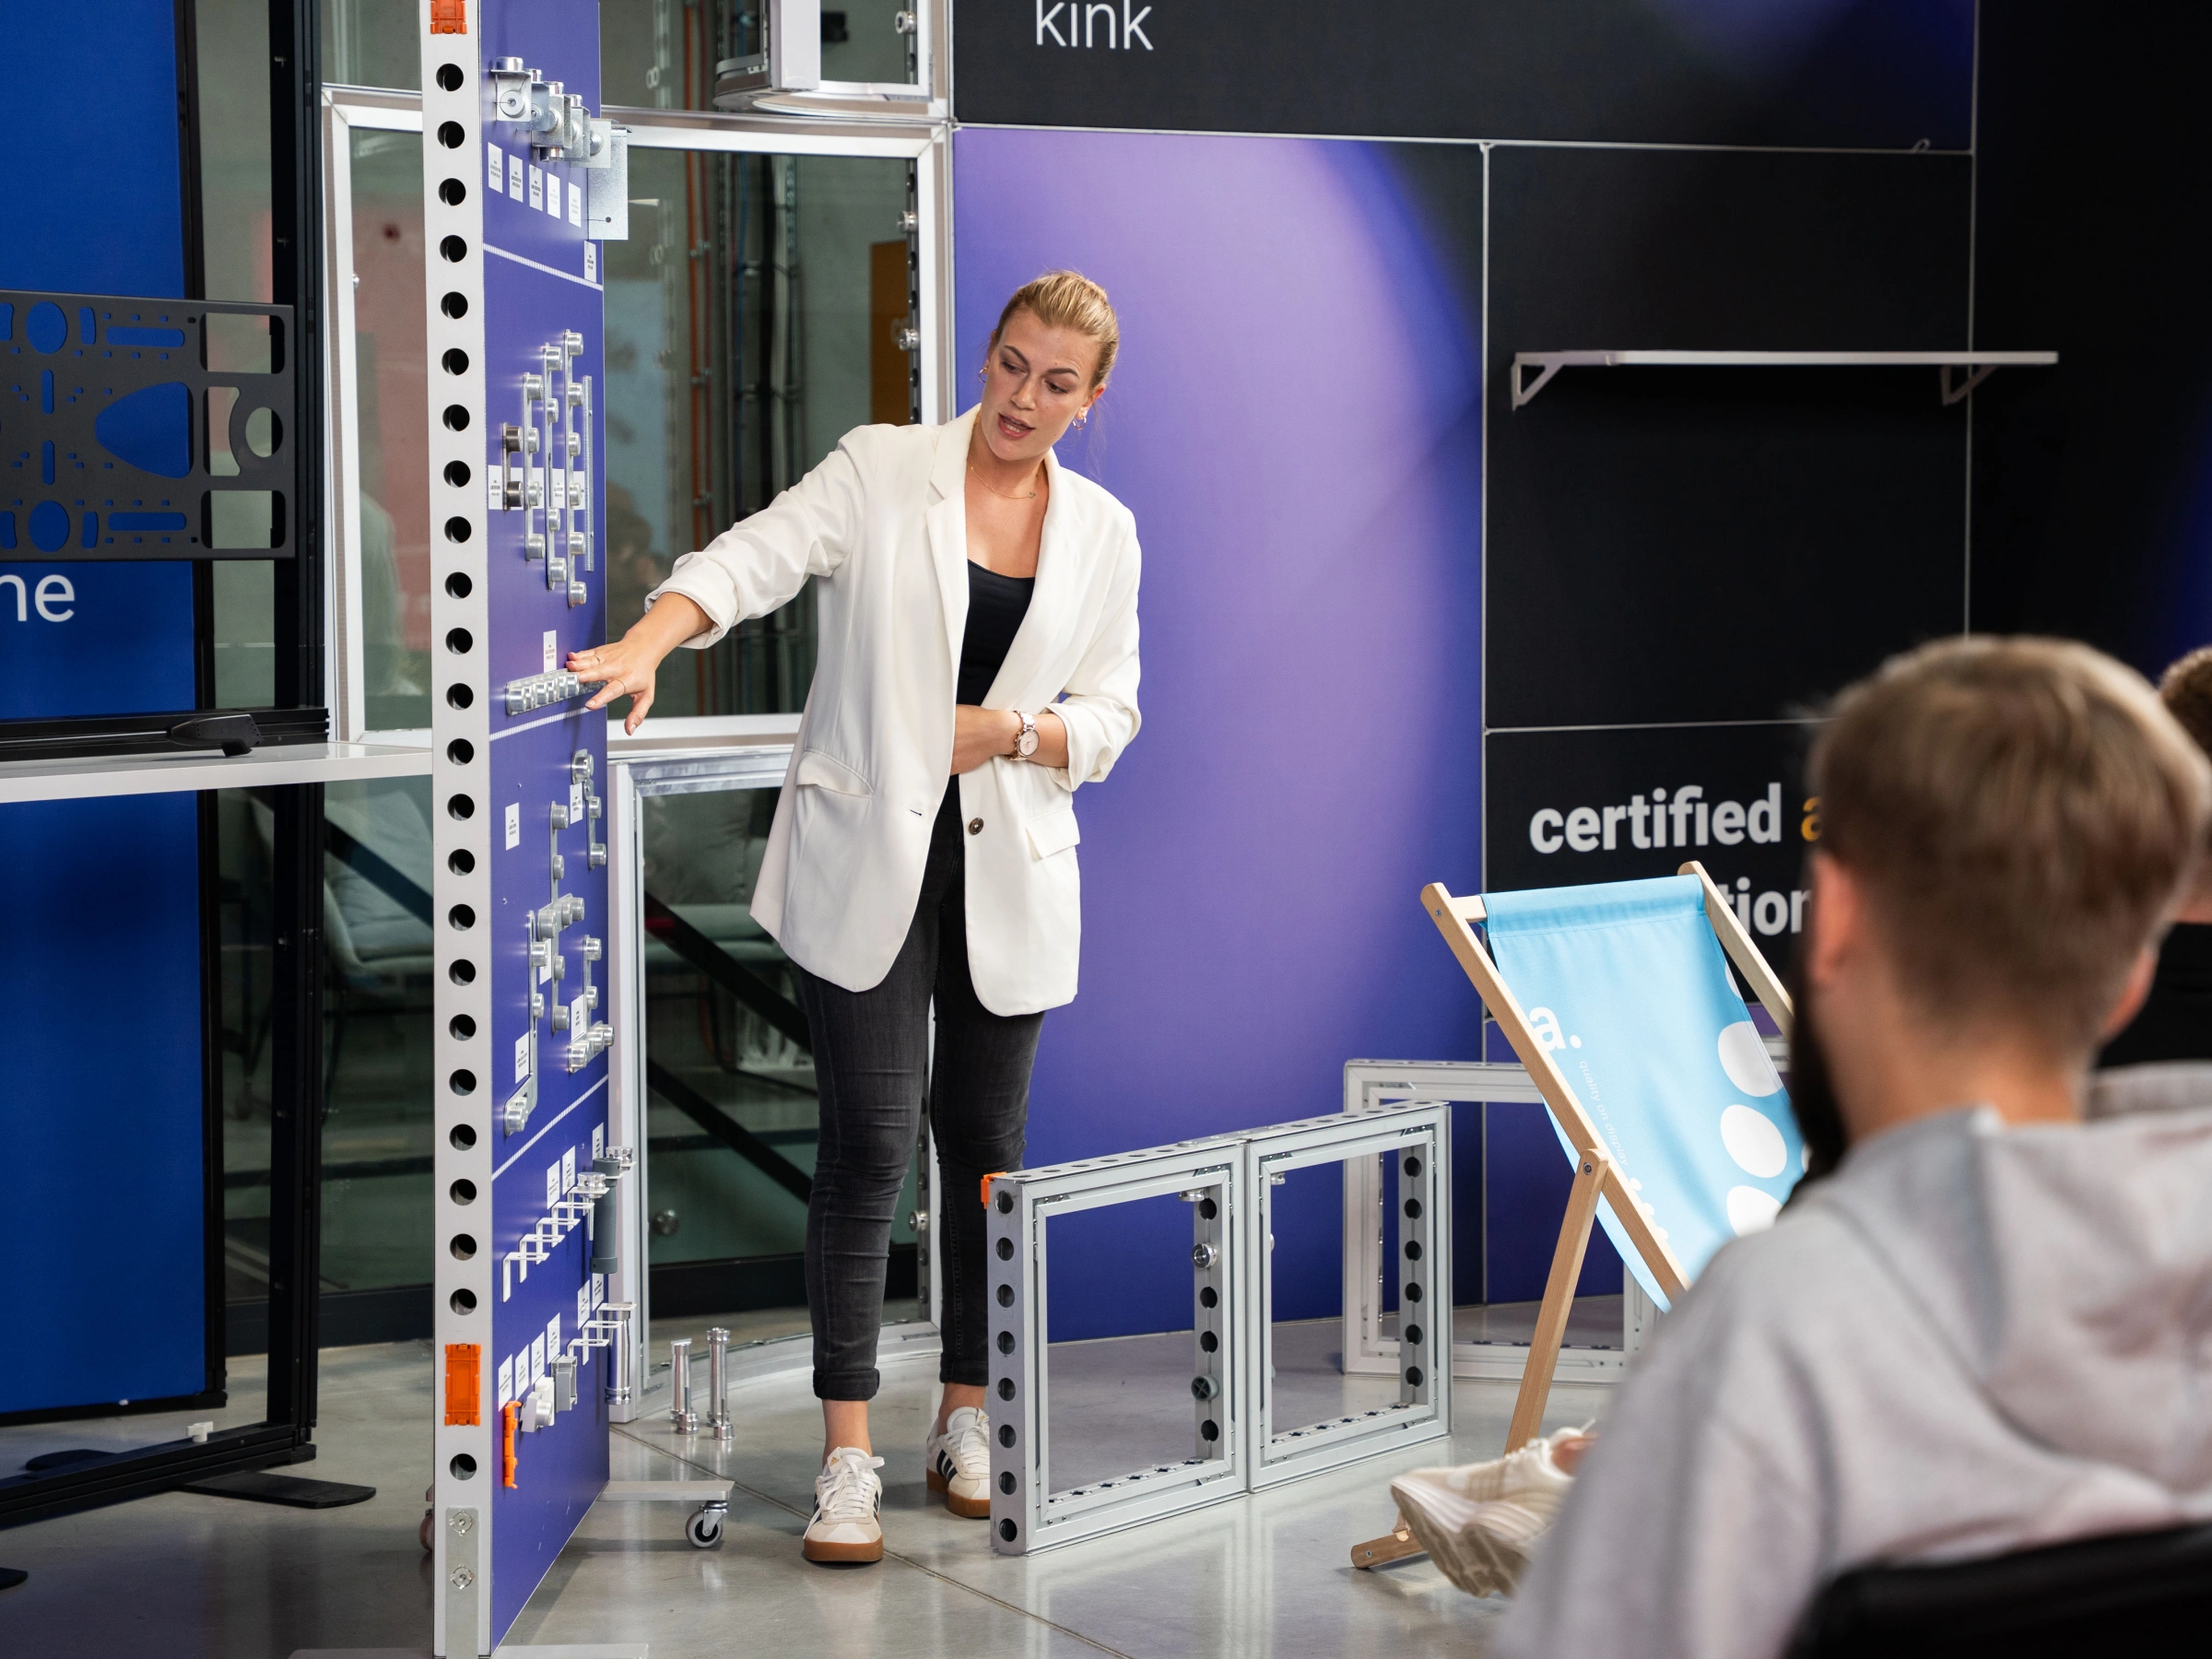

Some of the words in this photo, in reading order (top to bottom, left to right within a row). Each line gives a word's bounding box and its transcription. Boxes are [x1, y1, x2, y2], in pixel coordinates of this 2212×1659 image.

[1036, 0, 1154, 51] kink
[1529, 782, 1782, 854] certified
[1579, 1060, 1601, 1101] quality
[1597, 1104, 1608, 1120] on
[1605, 1124, 1630, 1166] display
